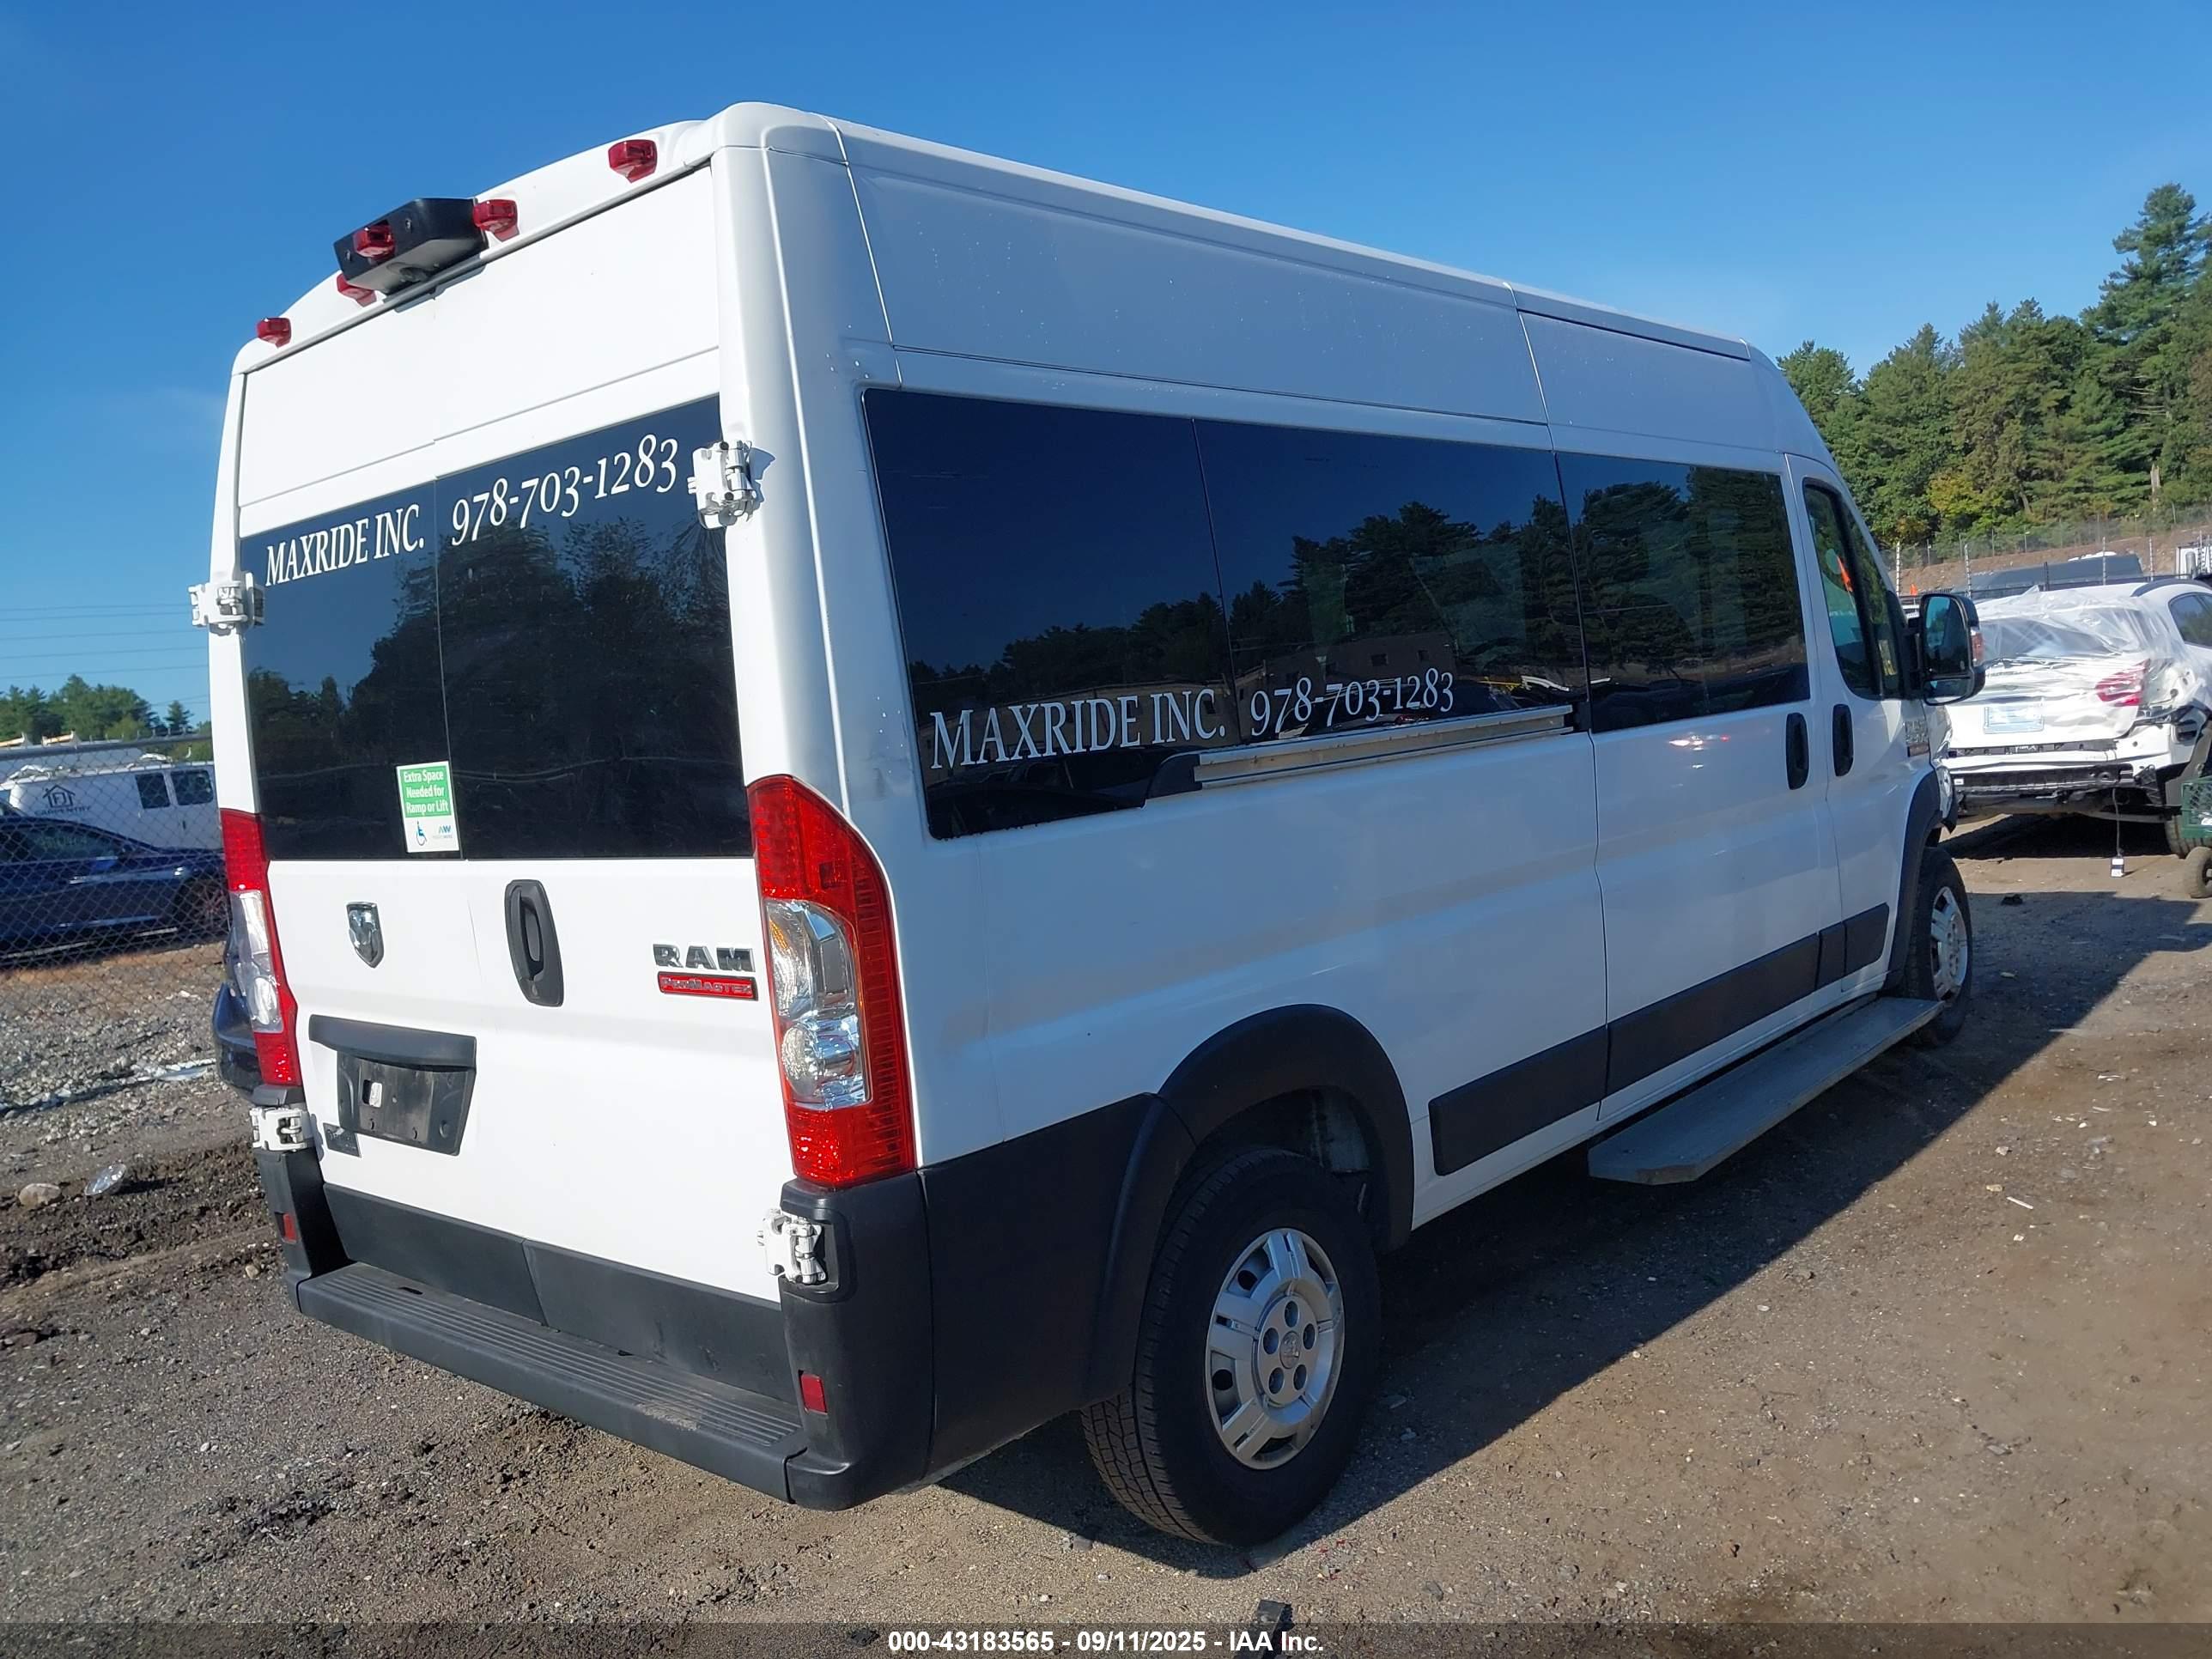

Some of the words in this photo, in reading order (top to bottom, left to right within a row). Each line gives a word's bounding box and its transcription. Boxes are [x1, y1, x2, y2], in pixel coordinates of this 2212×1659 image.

[265, 518, 368, 586] MAXRIDE
[374, 504, 424, 559] INC.
[452, 434, 678, 546] 978-703-1283
[930, 696, 1139, 769] MAXRIDE
[1152, 689, 1225, 744] INC.
[1249, 666, 1455, 737] 978-703-1283
[404, 771, 422, 782] Extra
[422, 769, 444, 783] Space
[406, 785, 433, 798] Needed
[434, 784, 445, 796] for
[406, 802, 426, 817] Ramp
[428, 804, 435, 813] or
[435, 799, 449, 812] Lift
[653, 944, 756, 972] RAM
